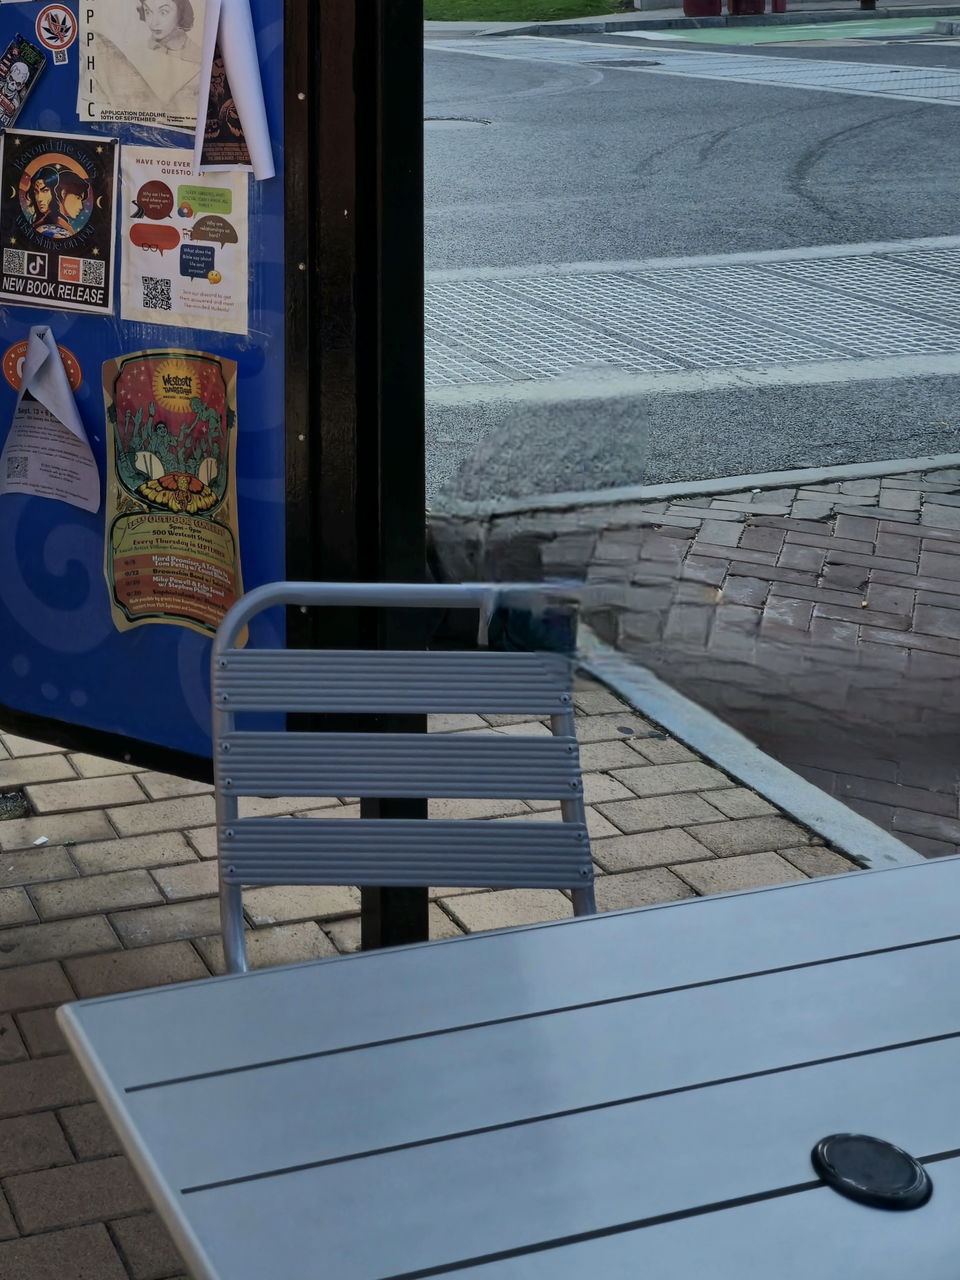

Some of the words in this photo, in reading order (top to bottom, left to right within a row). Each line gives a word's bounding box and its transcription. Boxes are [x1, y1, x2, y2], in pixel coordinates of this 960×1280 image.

[54, 139, 74, 152] the
[2, 277, 26, 292] NEW
[27, 281, 56, 297] BOOK
[58, 286, 104, 304] RELEASE
[162, 373, 192, 388] Westcott
[167, 530, 196, 539] Westcott
[155, 538, 189, 547] Thursday
[171, 561, 188, 570] Petty
